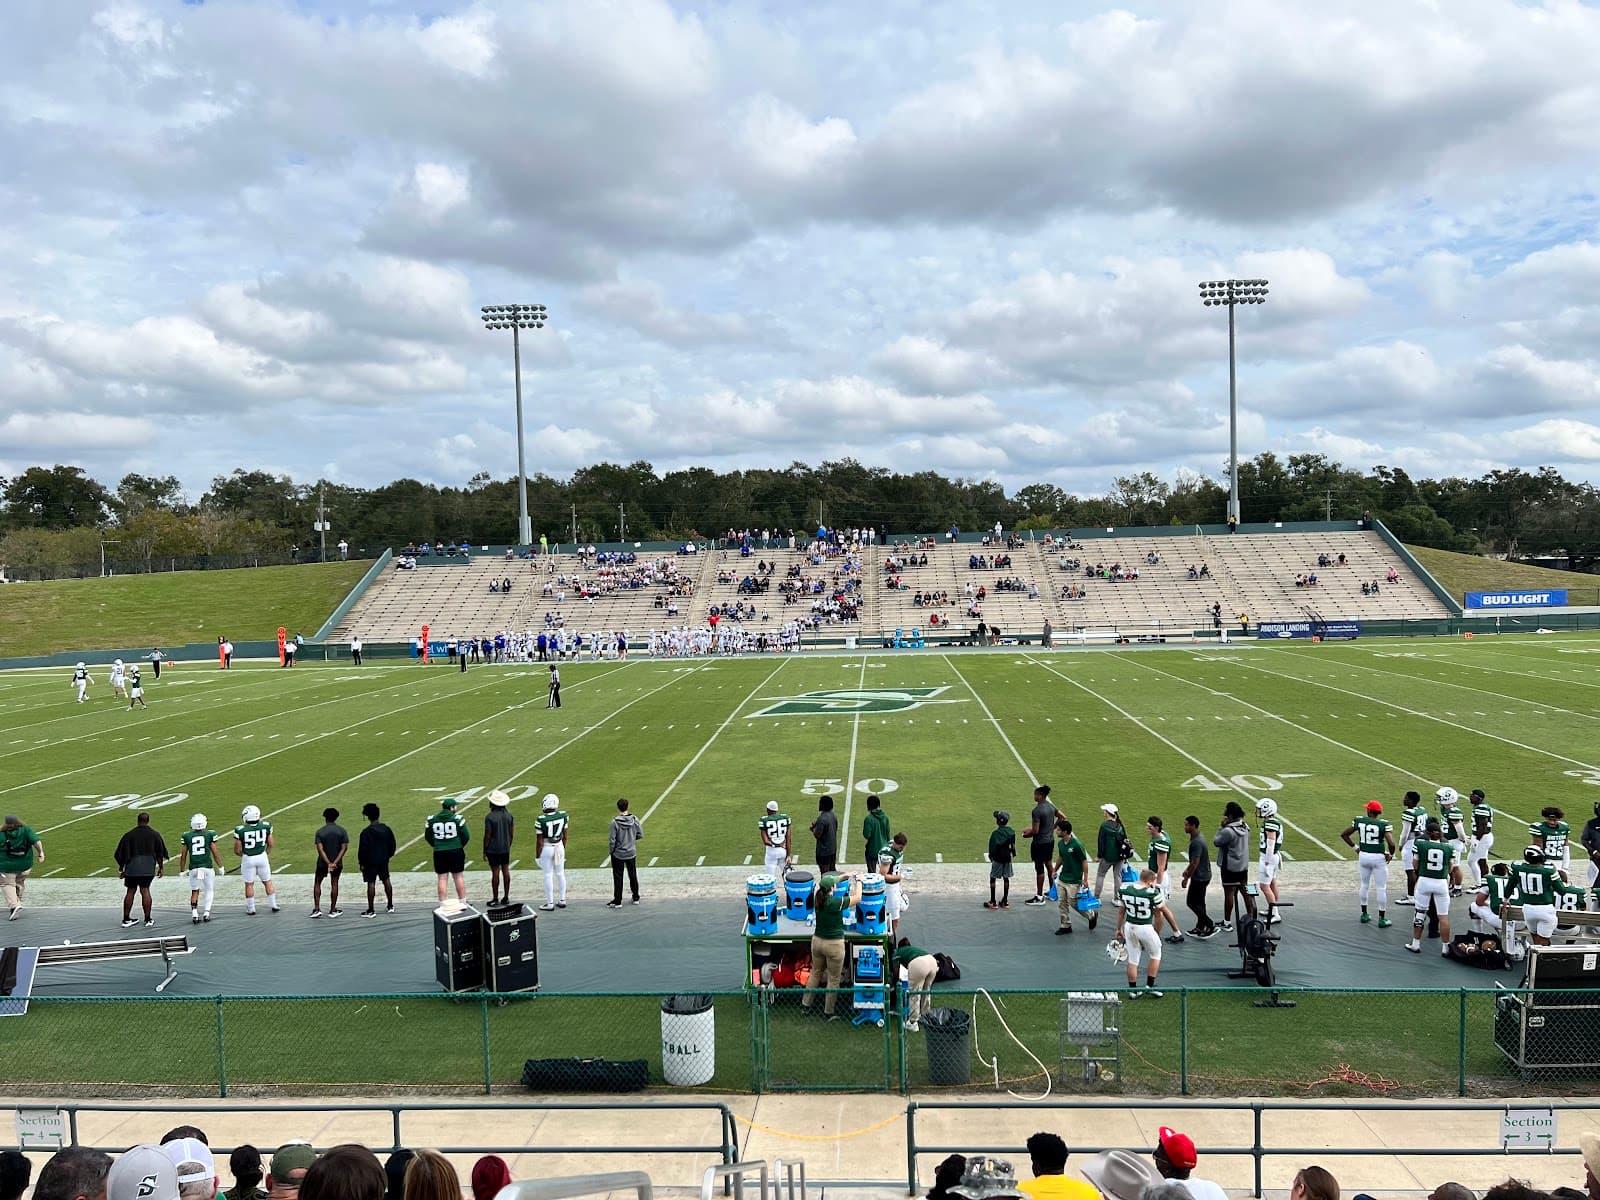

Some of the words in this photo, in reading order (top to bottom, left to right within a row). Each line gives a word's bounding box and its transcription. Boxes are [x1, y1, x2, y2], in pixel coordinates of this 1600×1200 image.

[1482, 595, 1510, 605] BUD
[1511, 594, 1550, 604] LIGHT
[1285, 623, 1310, 632] LANDING
[799, 778, 900, 796] 50
[1180, 774, 1285, 791] 40
[70, 792, 189, 811] 30
[432, 821, 458, 840] 99
[546, 818, 565, 838] 17
[765, 818, 788, 837] 26
[1357, 822, 1380, 845] 12
[191, 835, 206, 856] 2
[243, 828, 267, 849] 54
[1426, 848, 1444, 871] 9
[1518, 871, 1544, 895] 10
[1121, 894, 1151, 919] 53
[1553, 892, 1578, 911] 18
[19, 1115, 61, 1126] Section
[1503, 1115, 1553, 1127] Section
[38, 1130, 44, 1141] 4
[1524, 1131, 1532, 1142] 3
